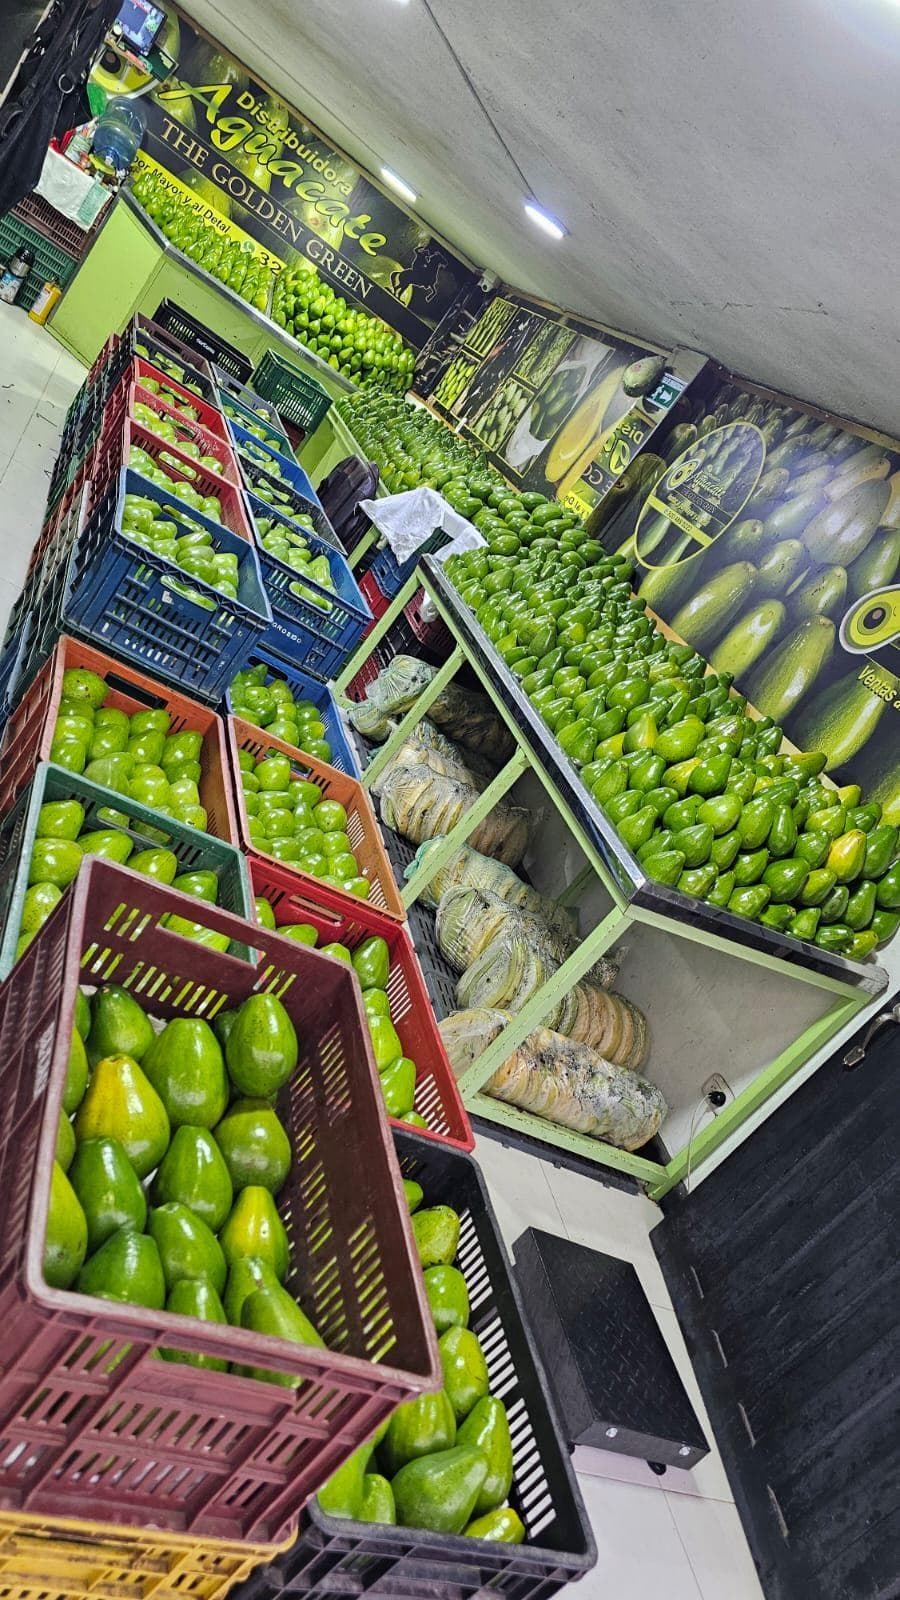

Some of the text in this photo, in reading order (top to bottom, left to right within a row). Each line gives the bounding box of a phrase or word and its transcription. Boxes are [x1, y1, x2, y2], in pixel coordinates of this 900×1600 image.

[158, 81, 387, 256] Aguacate
[236, 91, 352, 196] Distribuidora
[151, 168, 184, 195] Mayor
[183, 196, 192, 207] y
[192, 202, 204, 213] al
[203, 209, 230, 234] Detal
[161, 118, 373, 299] THE GOLDEN GREEN
[858, 665, 897, 701] Ventas
